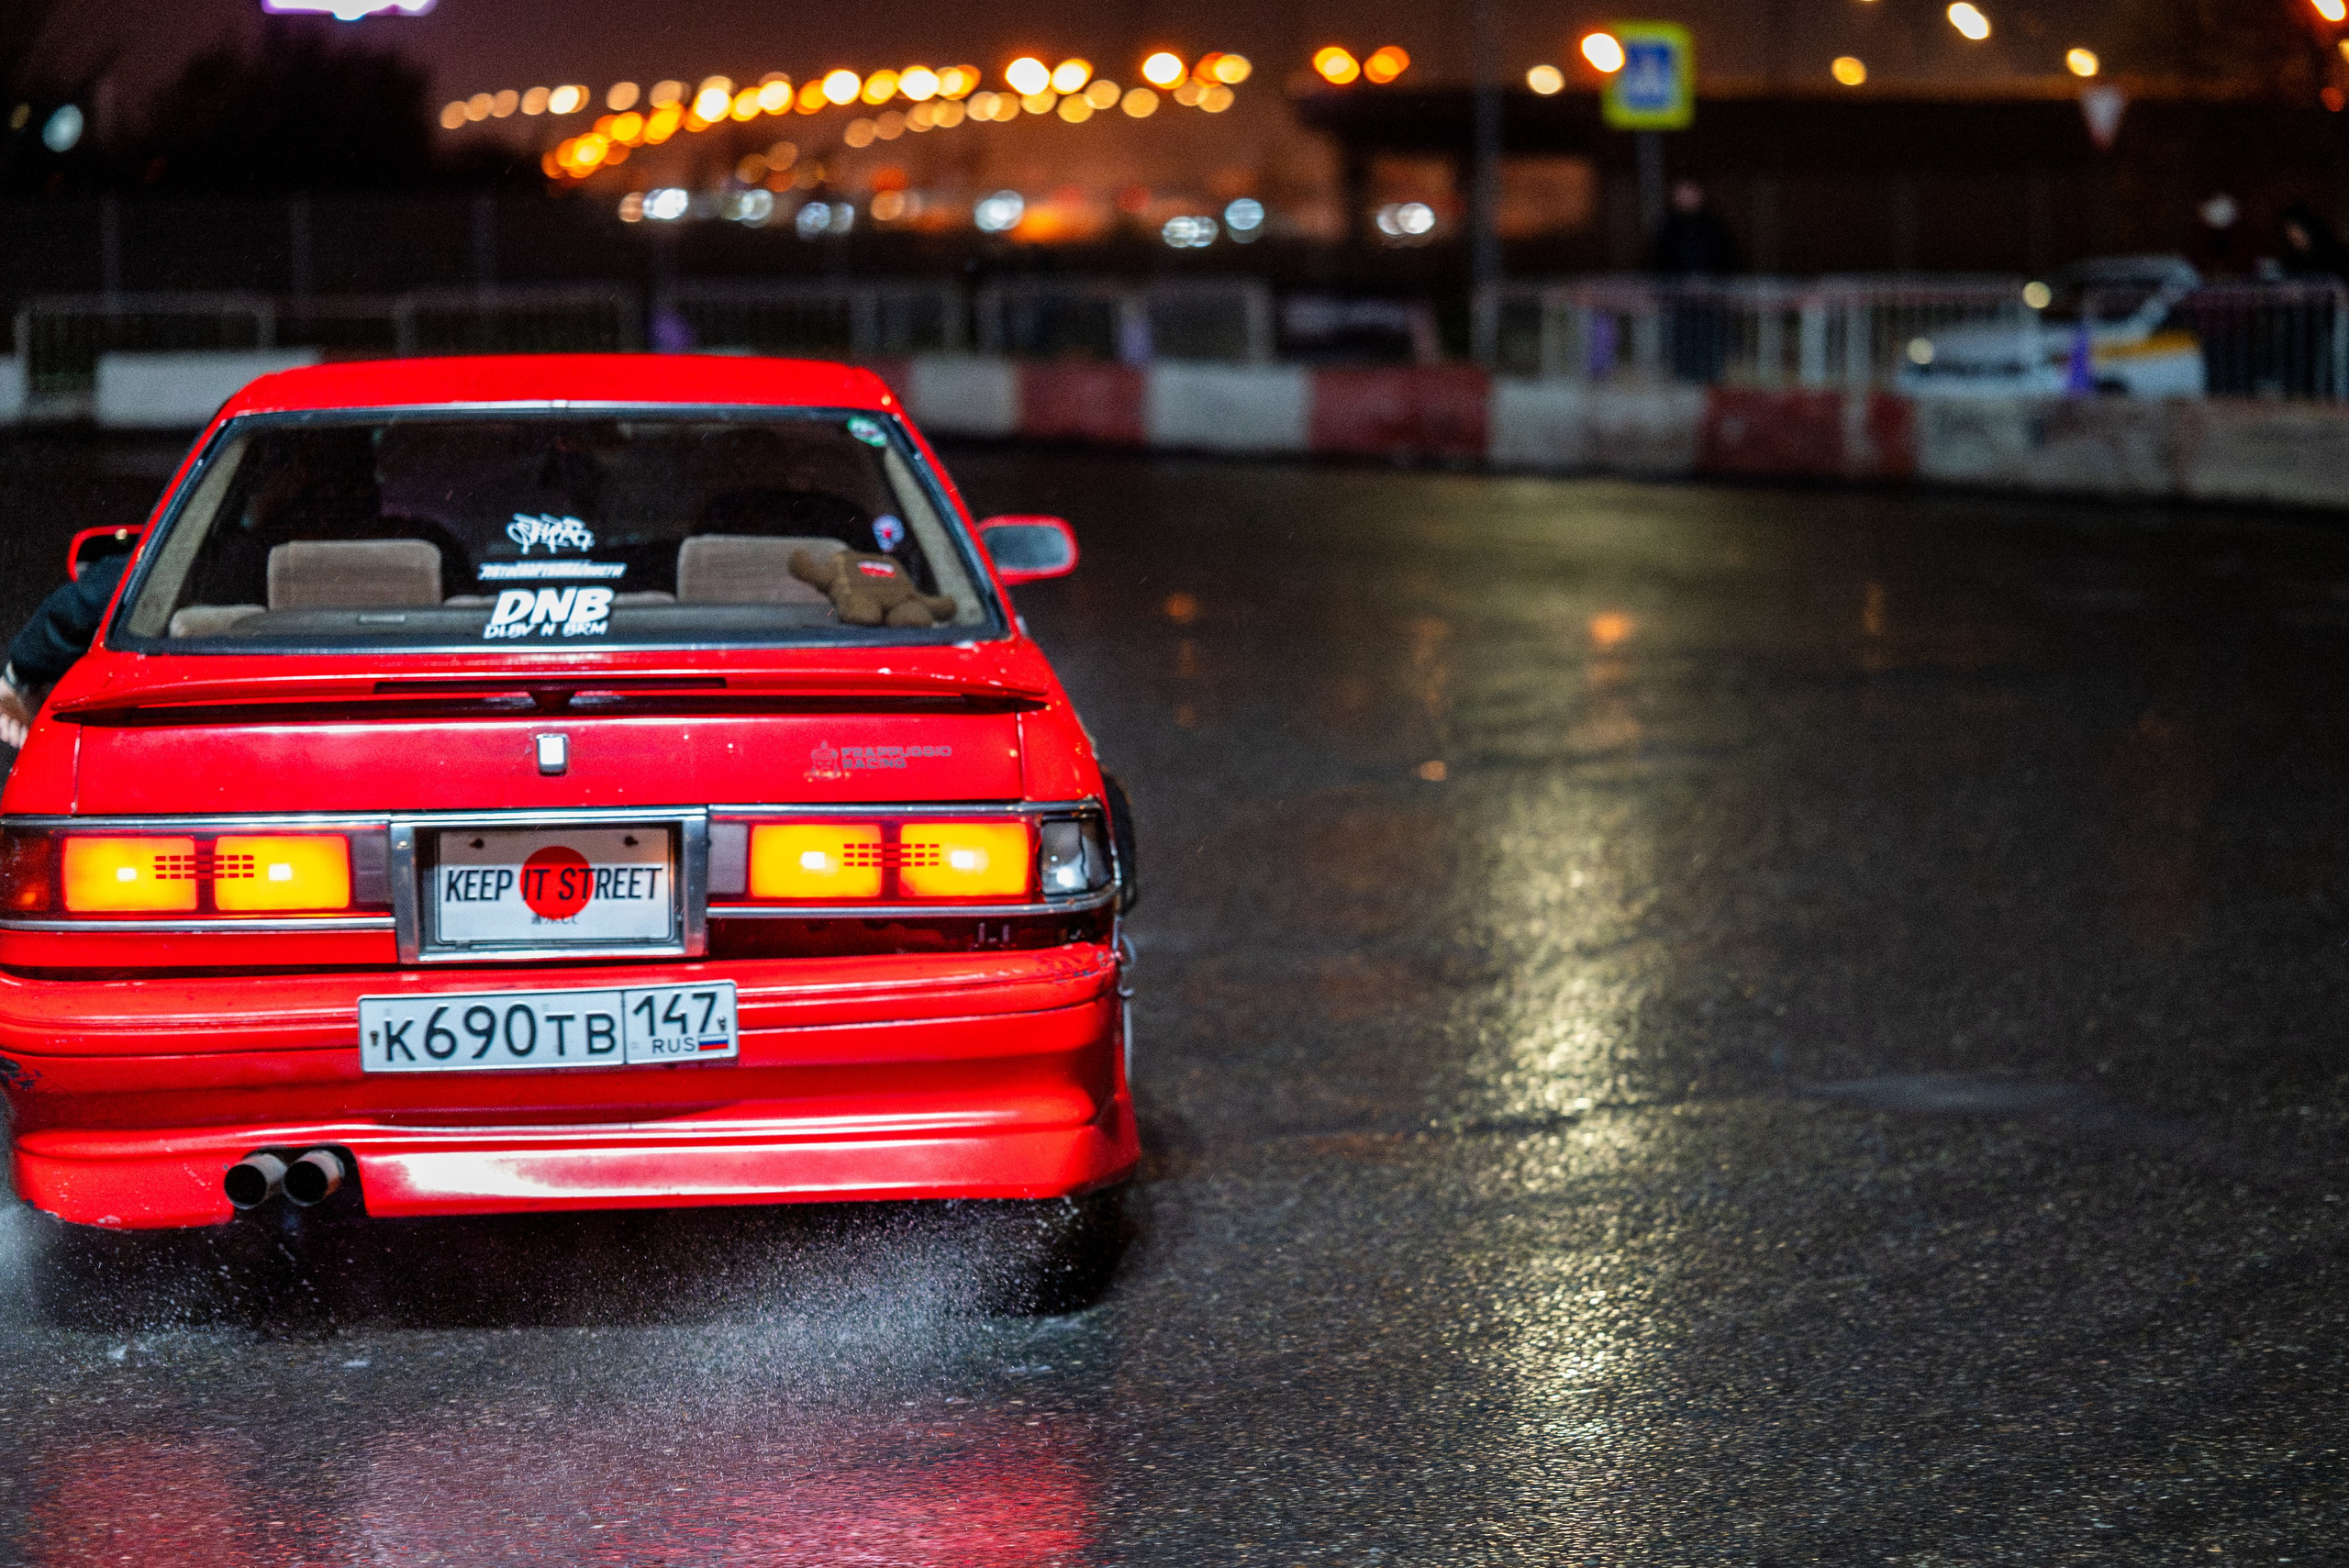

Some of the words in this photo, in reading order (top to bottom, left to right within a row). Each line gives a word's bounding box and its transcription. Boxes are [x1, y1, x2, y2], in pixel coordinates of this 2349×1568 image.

[490, 586, 614, 625] DNB
[540, 623, 557, 637] N
[842, 758, 906, 769] RACING
[446, 868, 514, 903] KEEP
[522, 868, 551, 902] IT
[559, 867, 663, 901] STREET
[631, 992, 718, 1038] 147
[651, 1037, 696, 1054] RUS
